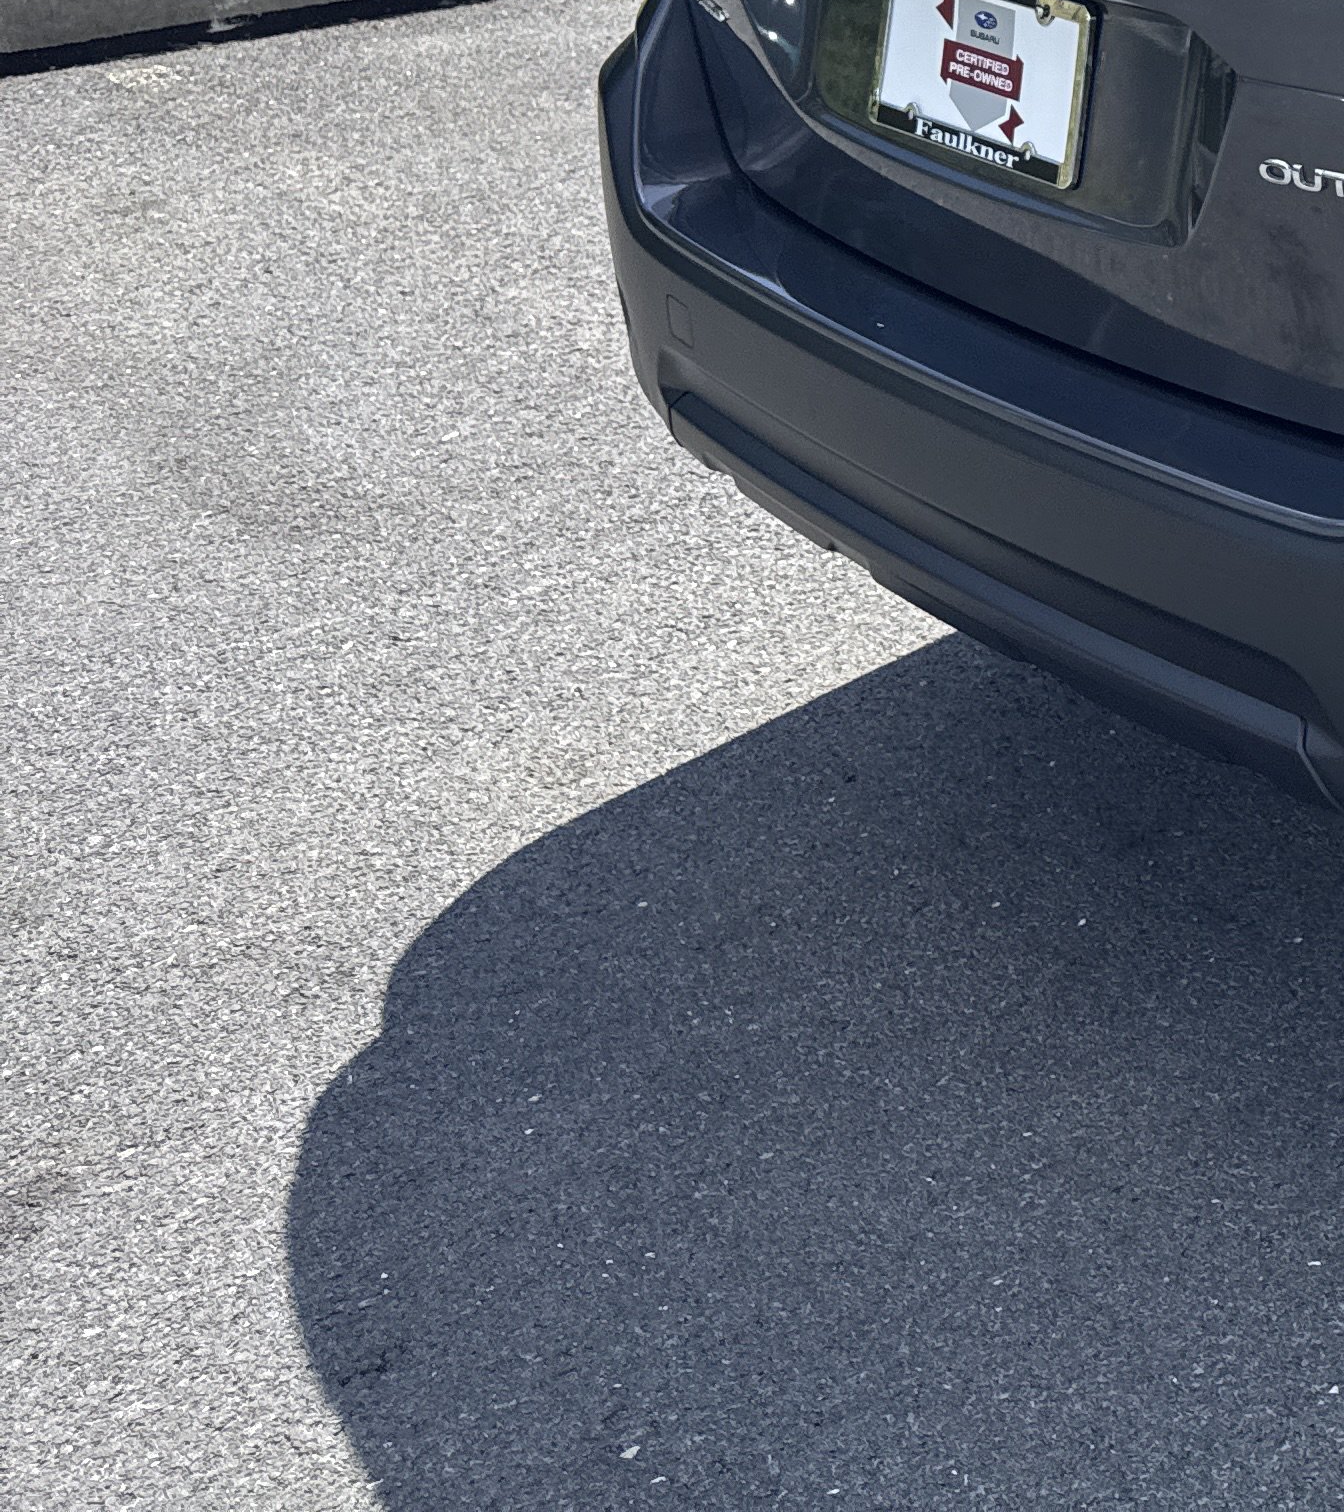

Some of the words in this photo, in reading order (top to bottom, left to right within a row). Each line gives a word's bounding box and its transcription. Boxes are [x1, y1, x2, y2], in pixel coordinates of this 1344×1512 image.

[970, 29, 1000, 45] SUBARU
[956, 48, 1010, 75] CERTIFIED
[949, 62, 1014, 92] PRE-OWNED
[914, 117, 1020, 170] Faulkner
